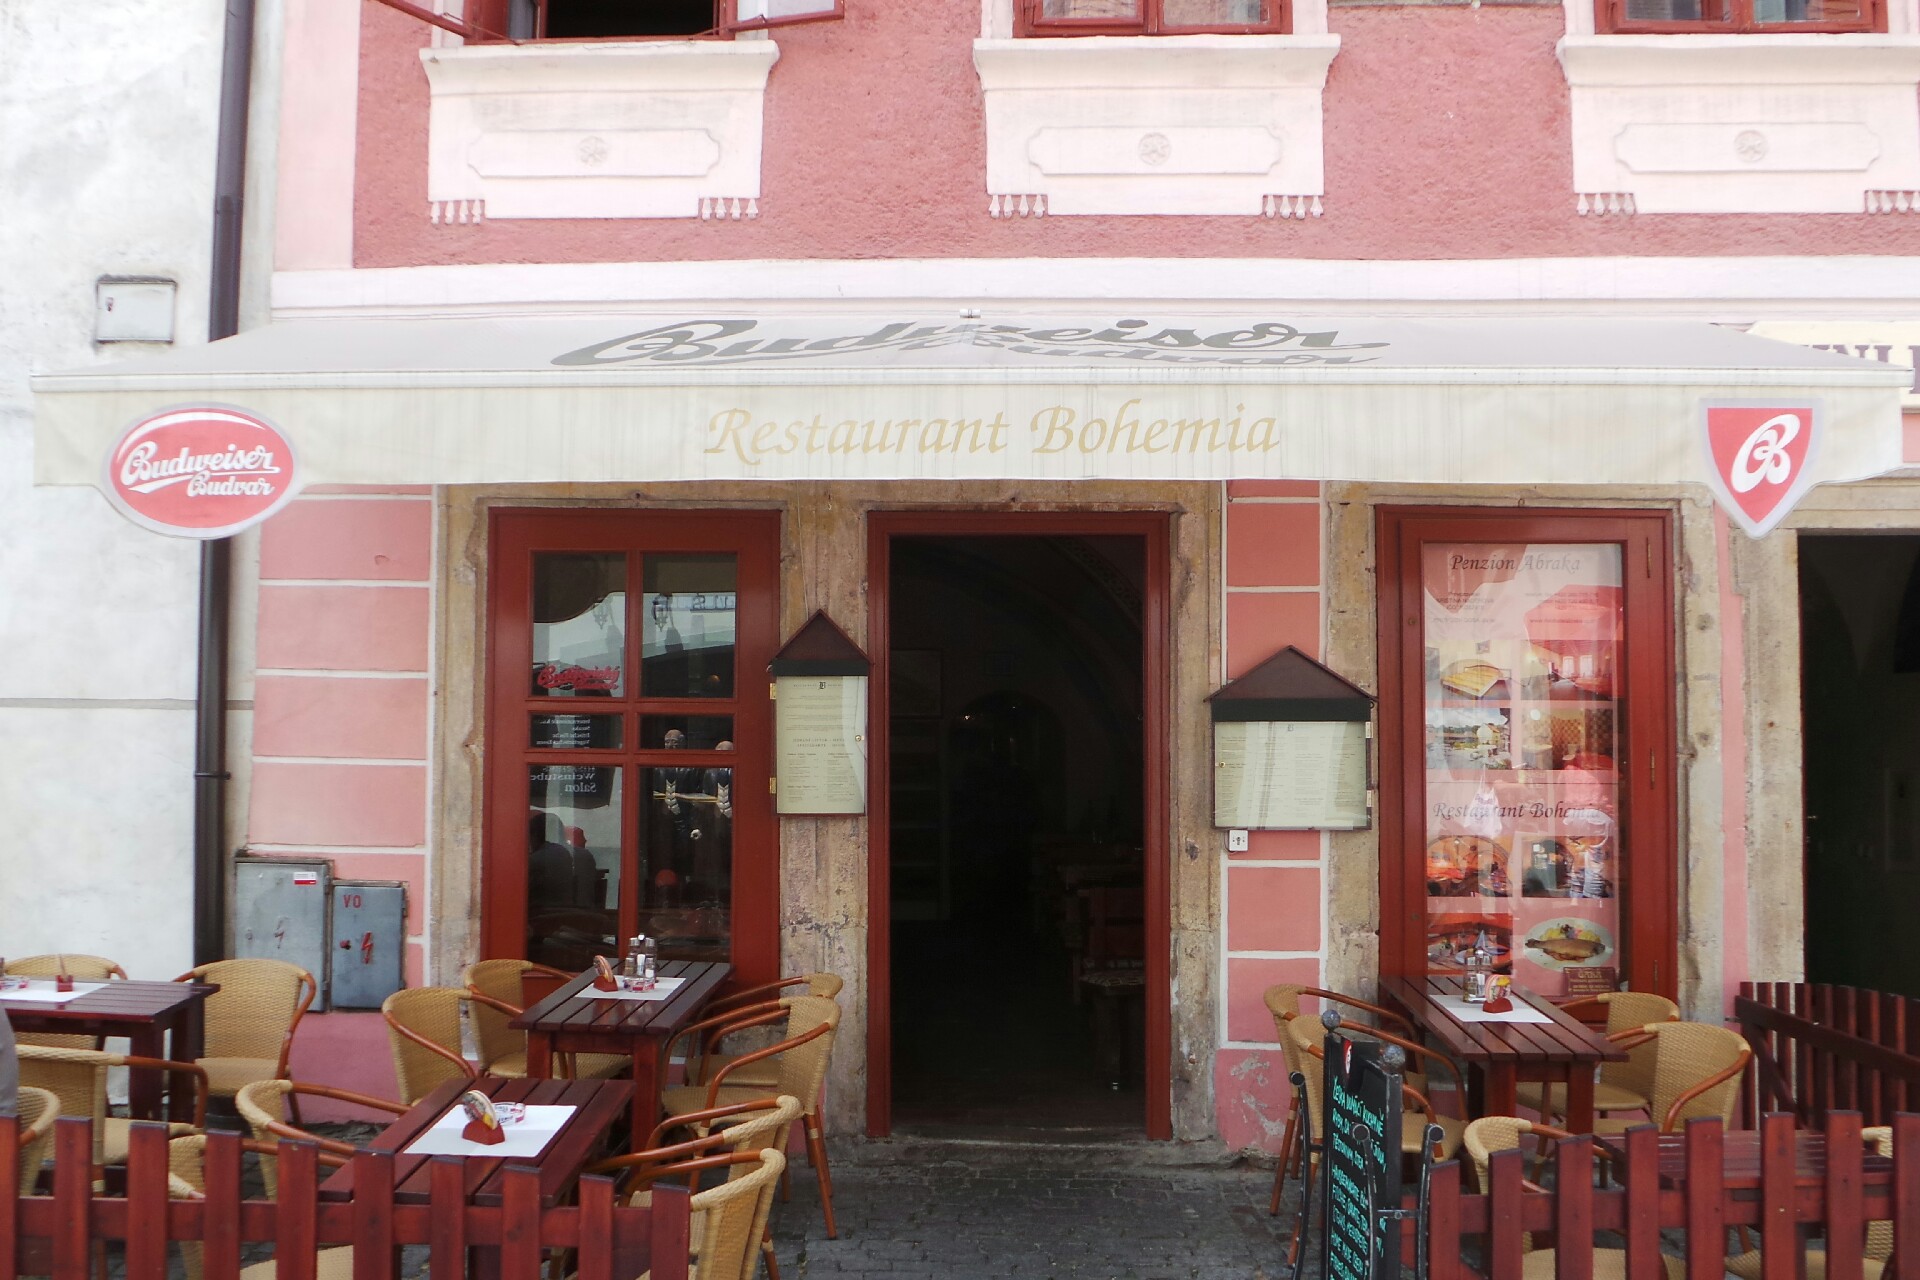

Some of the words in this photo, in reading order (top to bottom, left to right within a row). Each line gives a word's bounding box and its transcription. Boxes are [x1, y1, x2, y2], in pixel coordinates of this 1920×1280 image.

[703, 407, 1011, 466] Restaurant
[1029, 398, 1280, 455] Bohemia
[120, 441, 282, 488] Budweiser
[187, 471, 275, 498] Budvar
[1451, 554, 1515, 571] Penzion
[1519, 554, 1582, 574] Abraka
[1529, 801, 1601, 818] Bohemia
